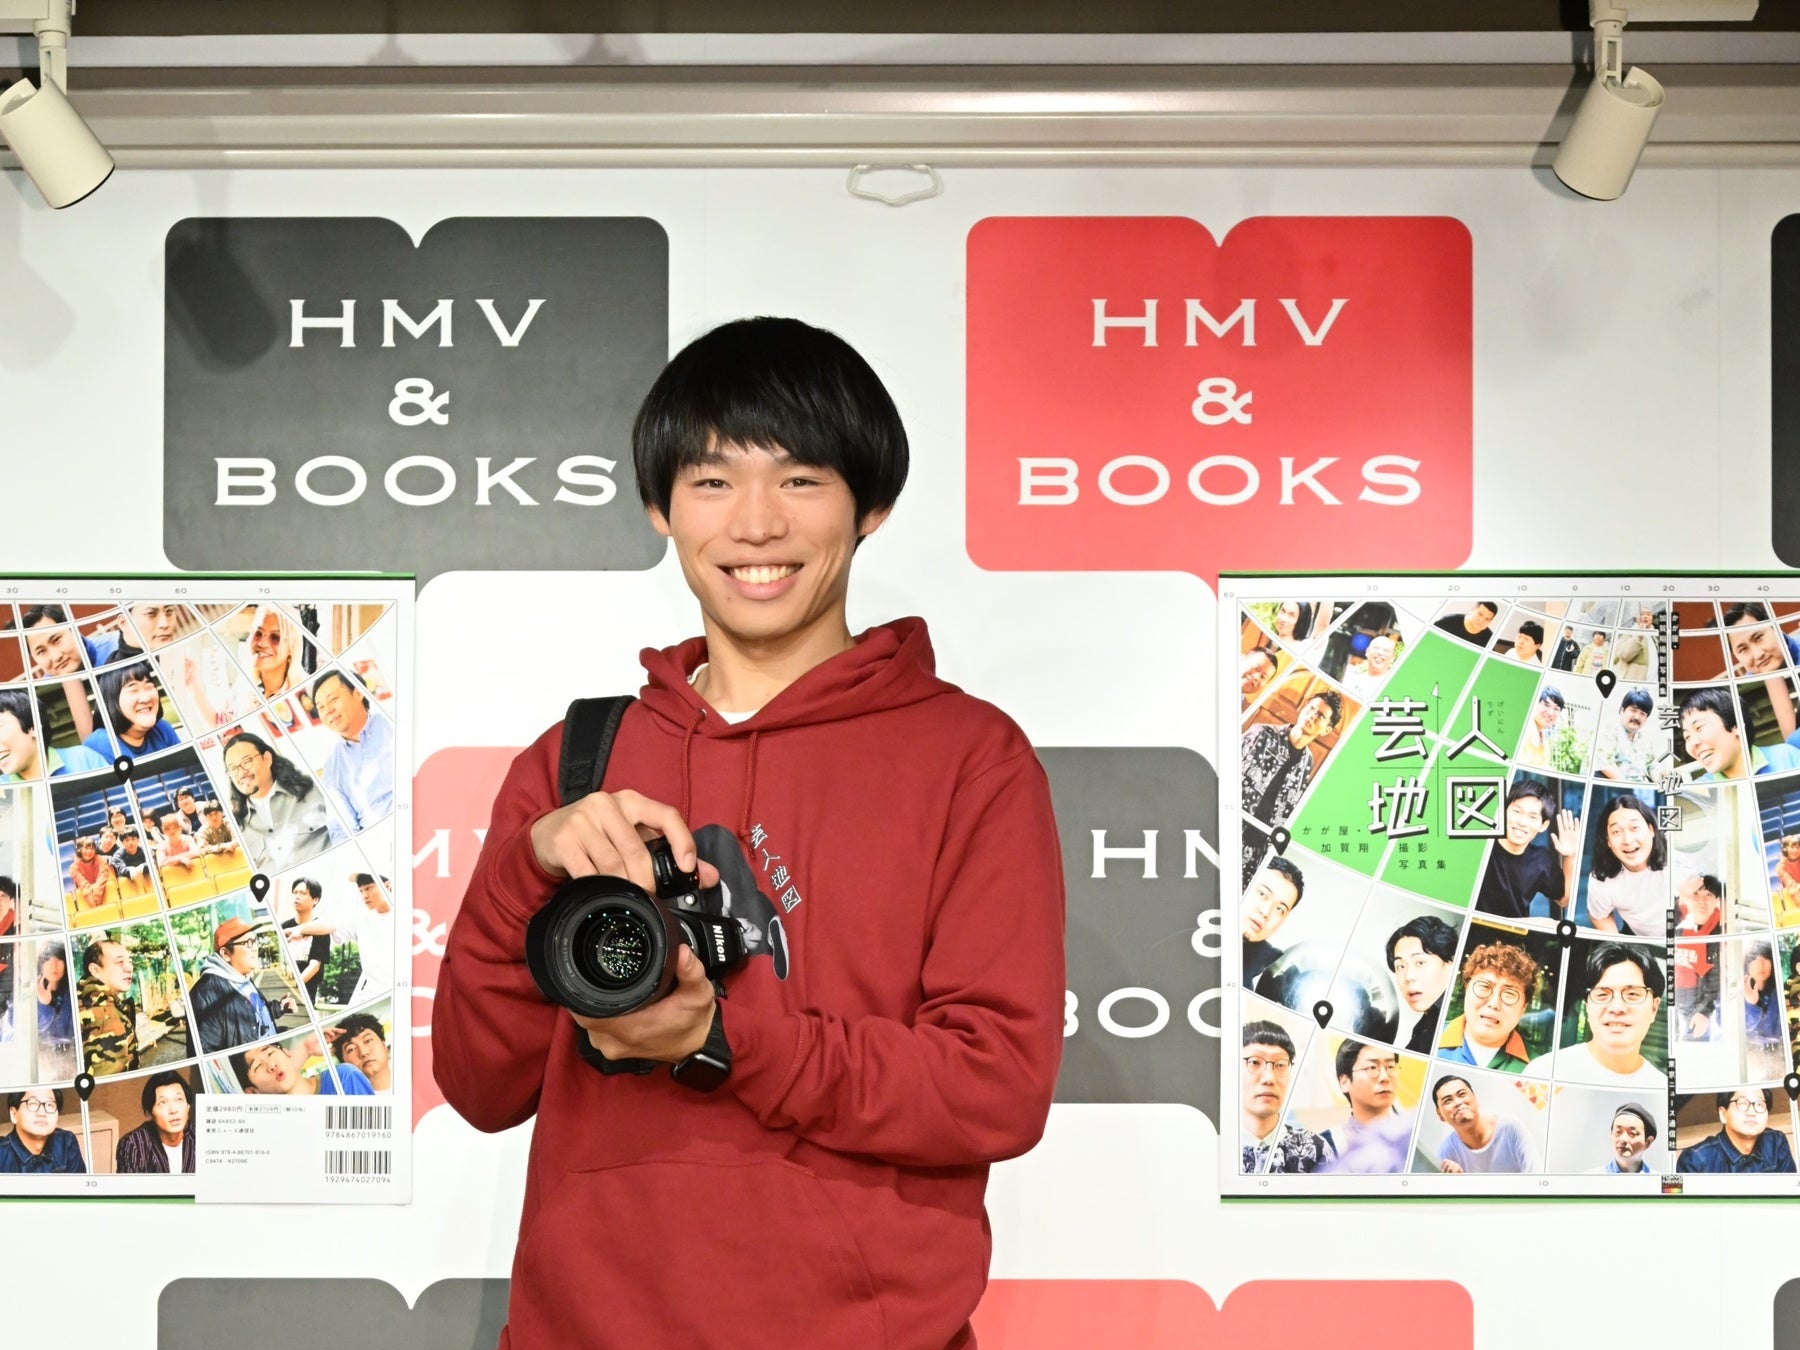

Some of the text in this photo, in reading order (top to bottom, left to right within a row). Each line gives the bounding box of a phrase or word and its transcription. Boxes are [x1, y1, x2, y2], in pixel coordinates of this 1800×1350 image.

[289, 299, 547, 348] HMV
[1091, 298, 1349, 347] HMV
[388, 377, 450, 426] &
[1191, 377, 1253, 426] &
[214, 455, 617, 506] BOOKS
[1017, 455, 1422, 506] BOOKS
[1517, 584, 1528, 592] 10
[1620, 584, 1631, 592] 10
[1368, 695, 1509, 763] 芸人
[1657, 702, 1683, 832] 芸人地図
[1367, 775, 1508, 840] 地図
[1398, 859, 1447, 871] 写真集
[712, 924, 726, 962] Nikon
[325, 1131, 392, 1139] 9784867019160
[85, 1180, 98, 1188] 30
[325, 1175, 391, 1184] 1929474027094
